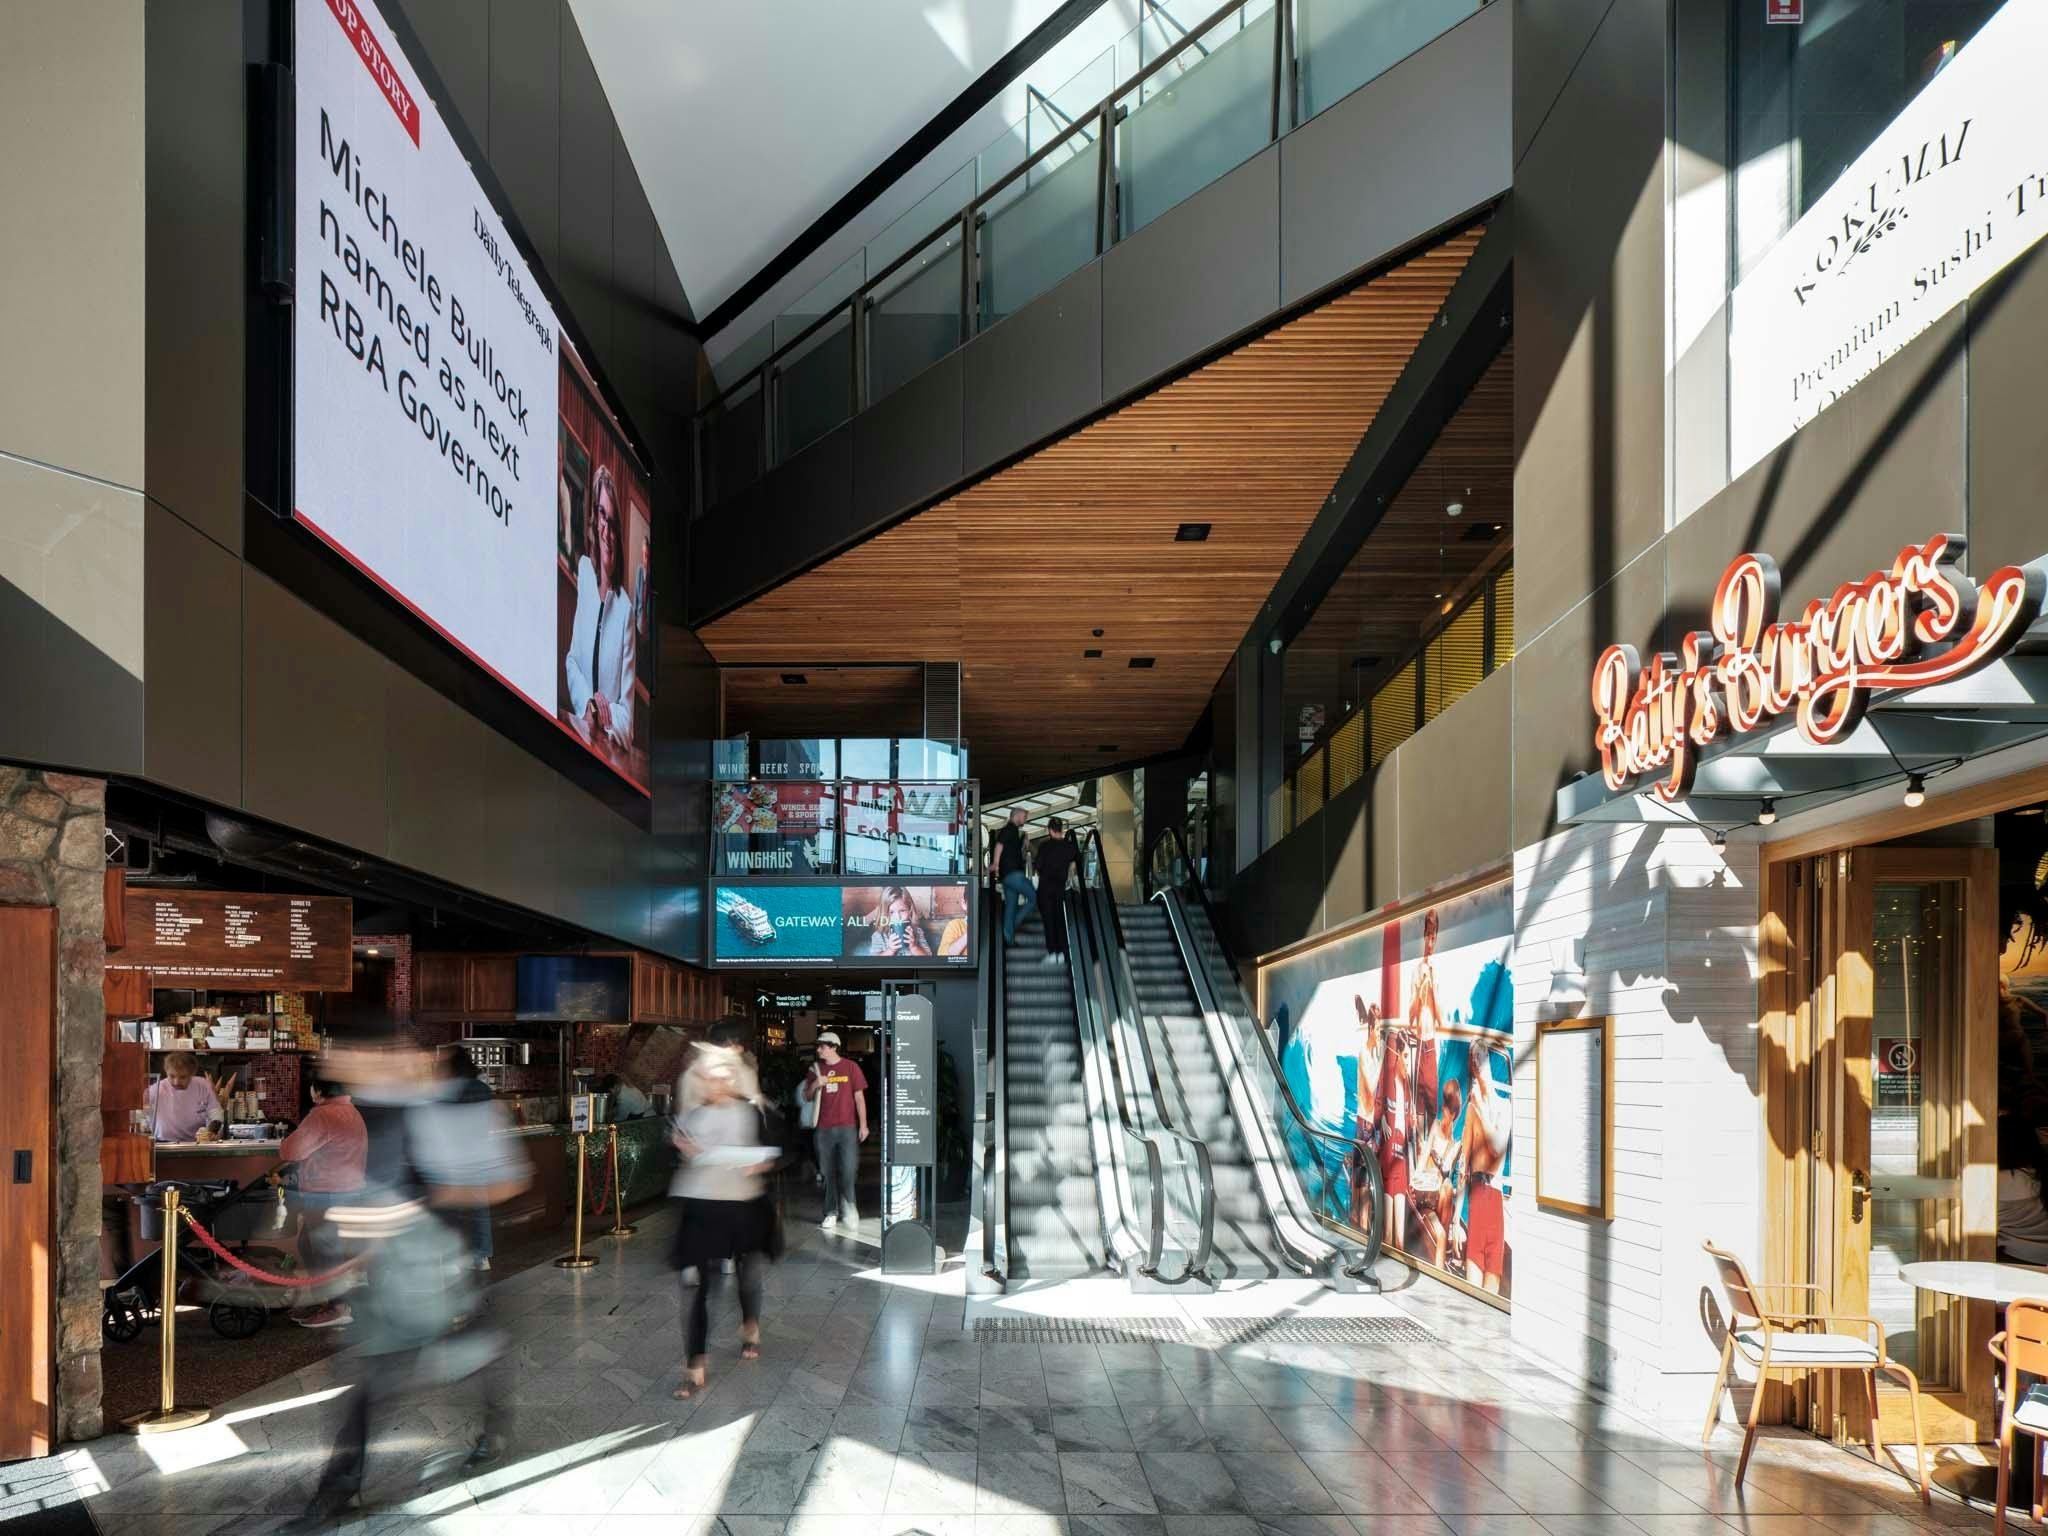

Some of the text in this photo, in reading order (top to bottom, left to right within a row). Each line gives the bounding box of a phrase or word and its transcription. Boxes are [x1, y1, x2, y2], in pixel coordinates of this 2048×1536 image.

[361, 29, 410, 121] STORY
[320, 107, 529, 437] Michele Bullock
[320, 197, 521, 482] named as next
[473, 206, 553, 355] Daily Telegraph
[1793, 300, 1900, 402] Premium
[1912, 210, 1993, 302] Sushi
[320, 268, 515, 529] RBA Governor
[1592, 533, 2045, 803] Betty's Burgers
[760, 764, 789, 774] BEERS
[775, 916, 836, 928] GATEWAY
[847, 916, 870, 927] ALL
